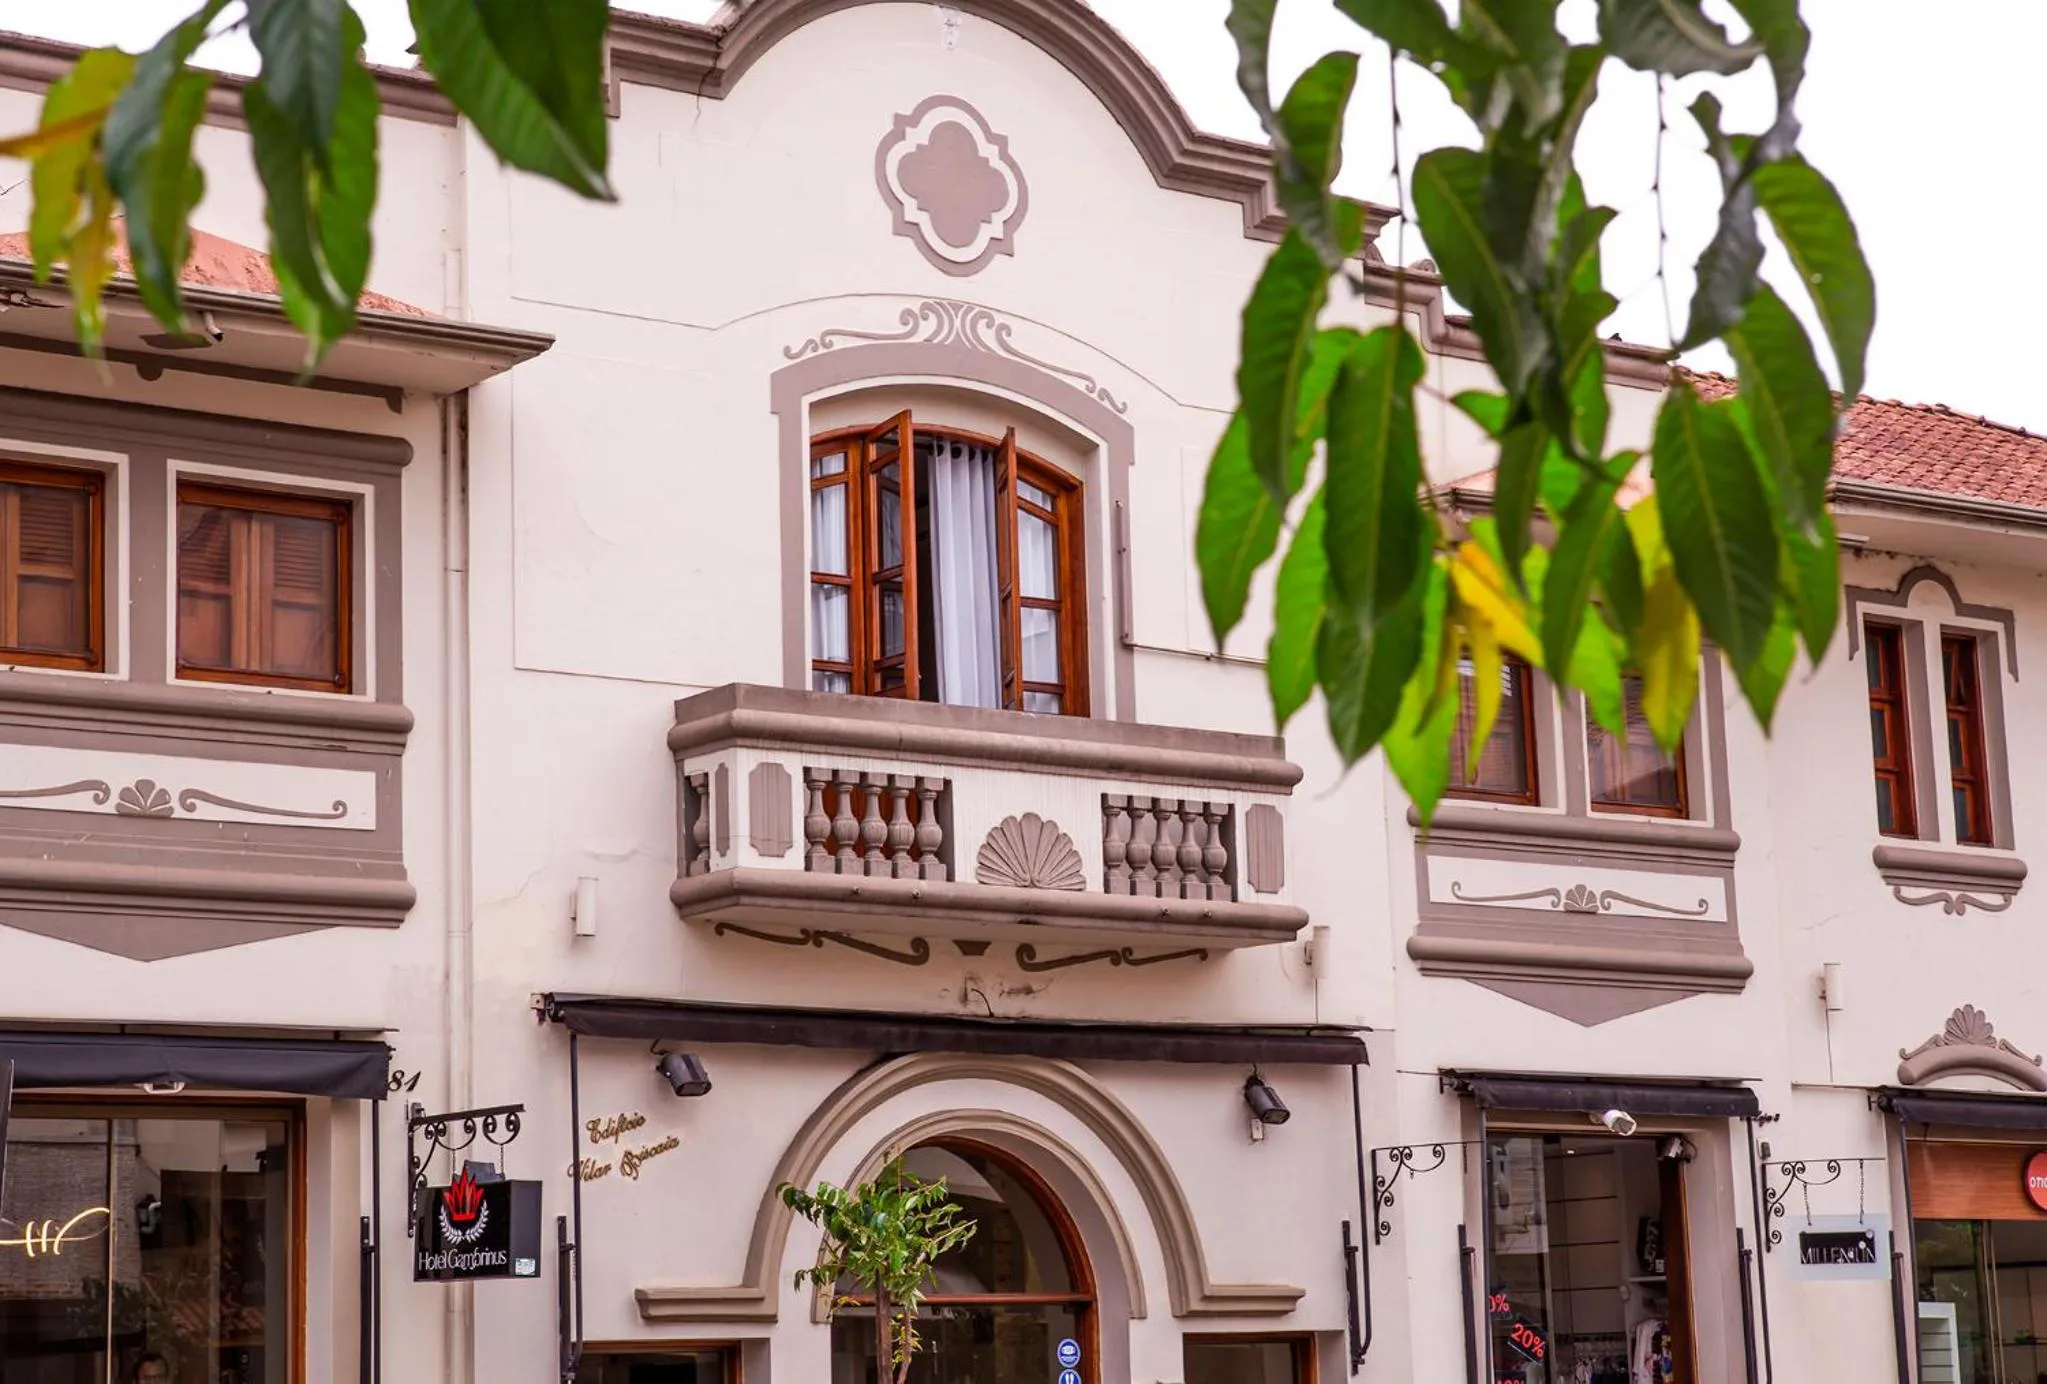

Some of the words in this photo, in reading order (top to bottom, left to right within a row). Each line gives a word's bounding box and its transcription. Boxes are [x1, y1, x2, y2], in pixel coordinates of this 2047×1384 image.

[388, 1069, 421, 1092] 81
[418, 1248, 447, 1271] Hotel
[448, 1246, 508, 1270] Gambrinus
[1510, 1323, 1546, 1358] 20%
